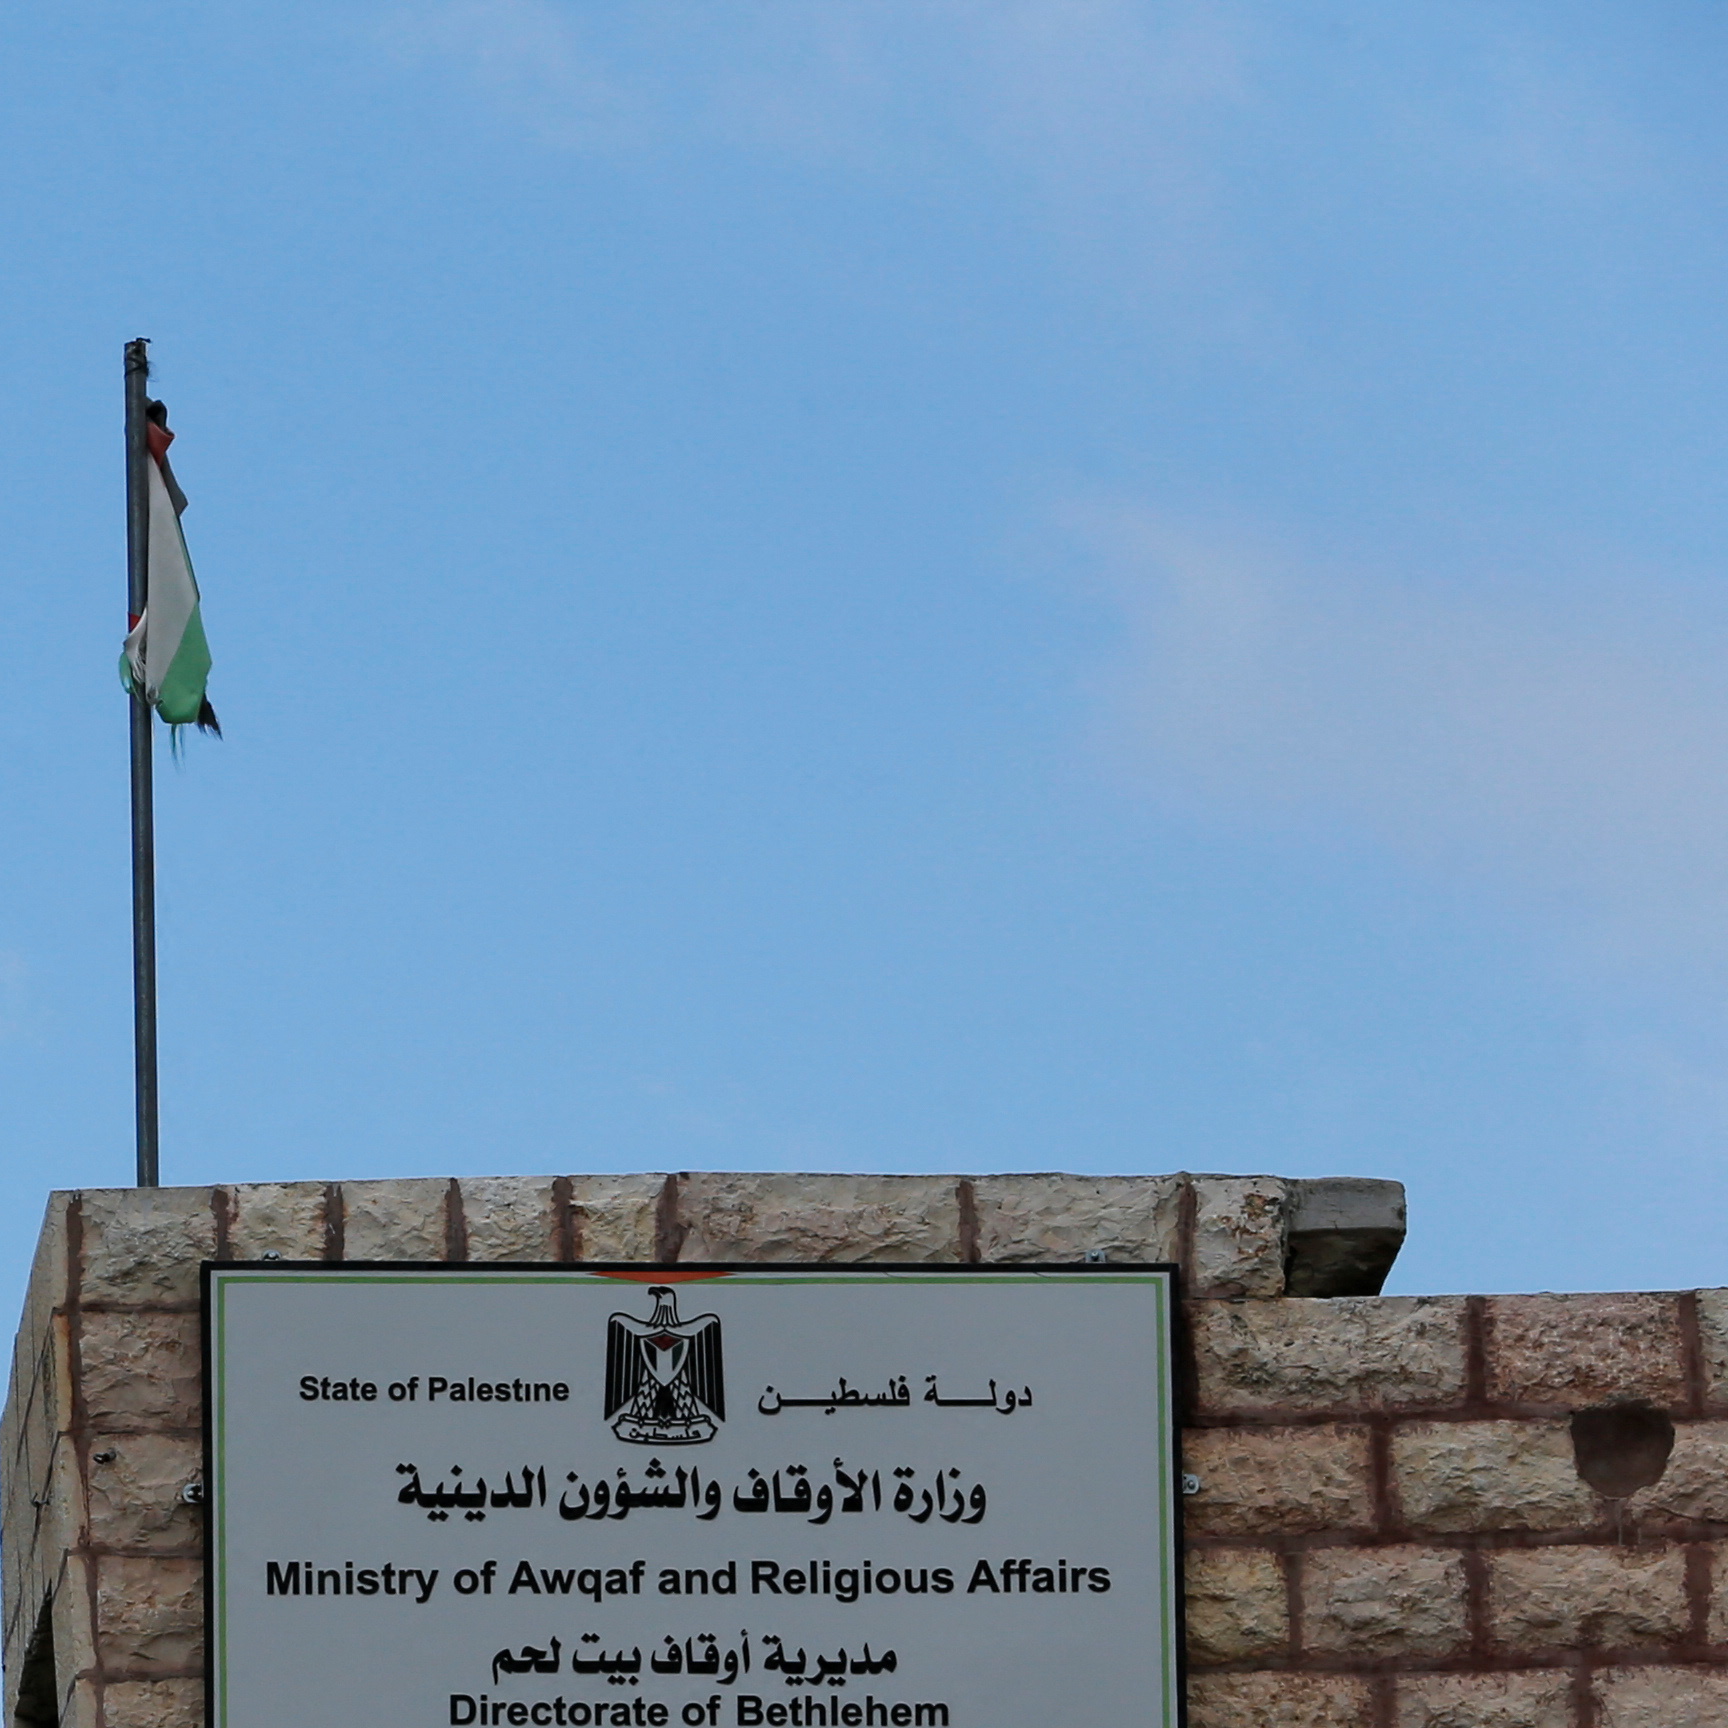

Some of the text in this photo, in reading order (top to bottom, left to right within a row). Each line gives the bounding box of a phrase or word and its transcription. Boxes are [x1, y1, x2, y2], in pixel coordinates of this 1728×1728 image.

[299, 1376, 569, 1402] State of Palestine
[395, 1457, 986, 1525] وزارة الأوقاف والشؤون الدينية
[267, 1559, 1111, 1604] Ministry of Awqaf and Religious Affairs
[492, 1629, 897, 1687] مديرية أوقاف بيت لحم
[450, 1695, 949, 1727] Directorate of Bethlehem
